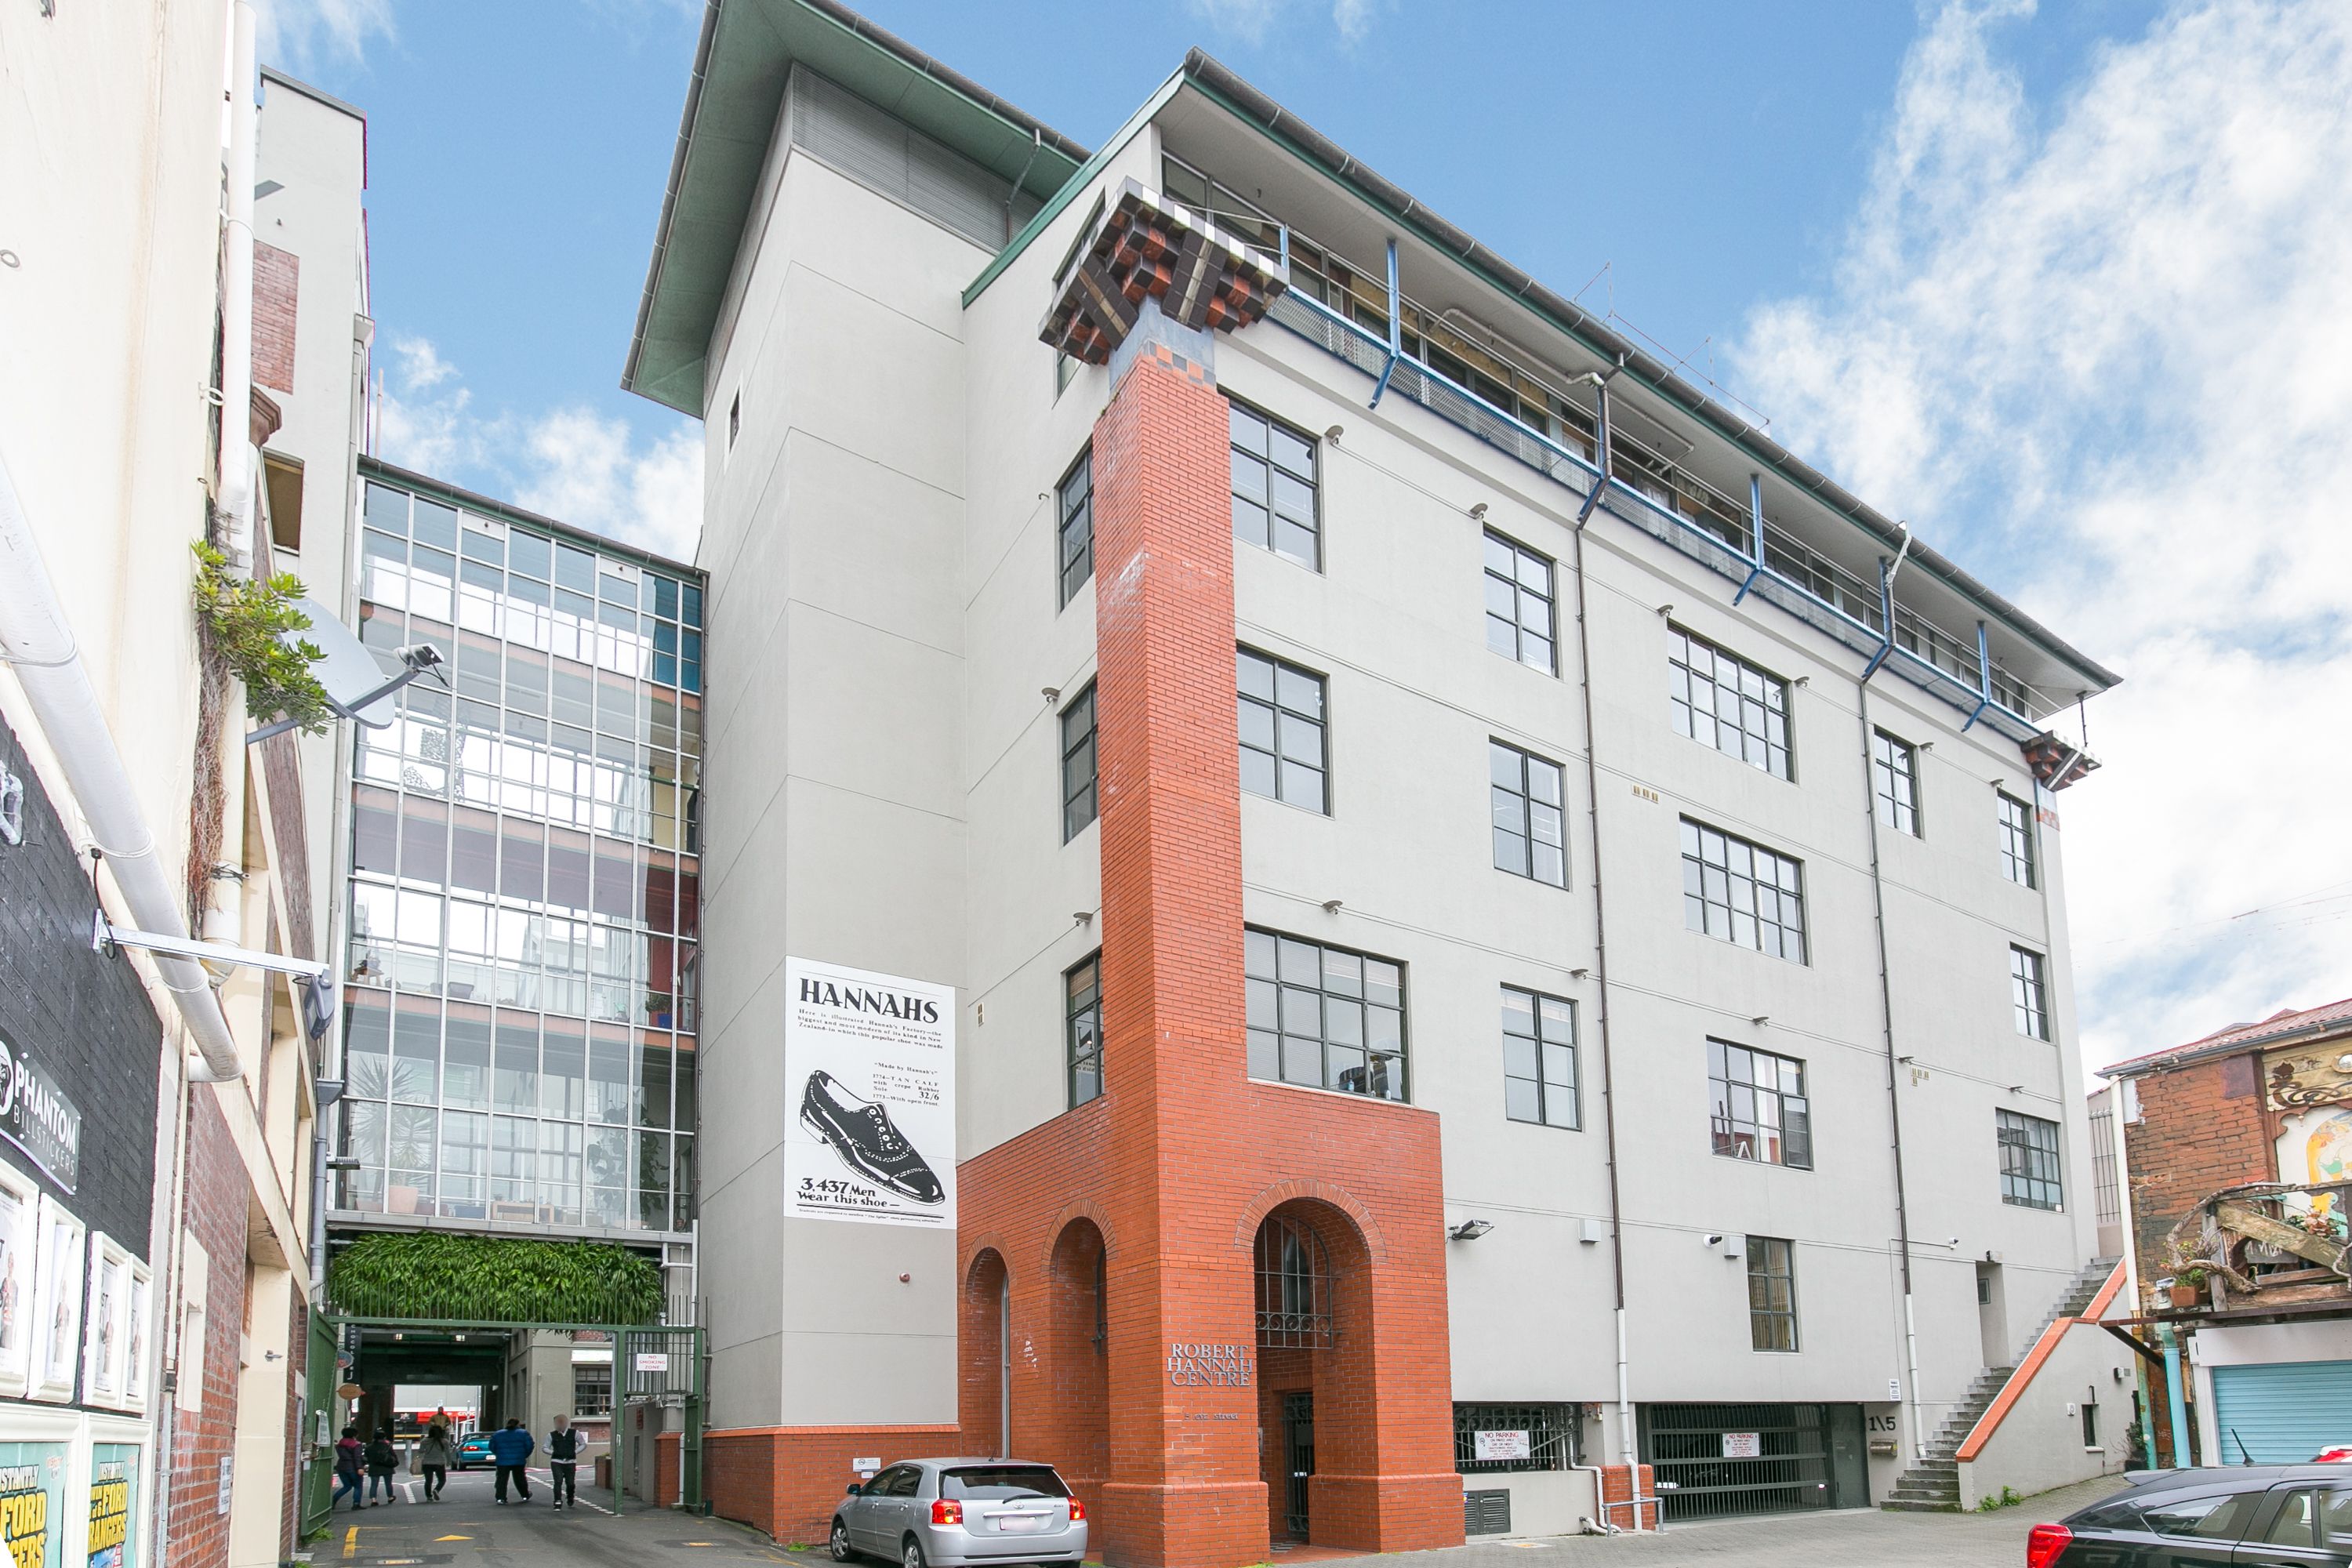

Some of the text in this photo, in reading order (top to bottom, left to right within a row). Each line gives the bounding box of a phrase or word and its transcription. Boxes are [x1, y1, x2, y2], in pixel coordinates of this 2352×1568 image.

[799, 978, 938, 1023] HANNAHS
[14, 1059, 77, 1155] PHANTOM
[919, 1091, 939, 1101] 32/6
[13, 1104, 75, 1176] BILLSTICKERS
[796, 1190, 829, 1202] Wear
[834, 1193, 858, 1204] this
[860, 1196, 887, 1207] shoe
[849, 1184, 877, 1197] Men
[1167, 1357, 1253, 1372] HANNAH
[1171, 1343, 1249, 1359] ROBERT
[1171, 1371, 1250, 1387] CENTRE
[0, 1465, 39, 1493] STANTLY
[103, 1483, 129, 1516] FORD
[0, 1491, 47, 1541] FORD
[88, 1512, 127, 1555] RANGERS
